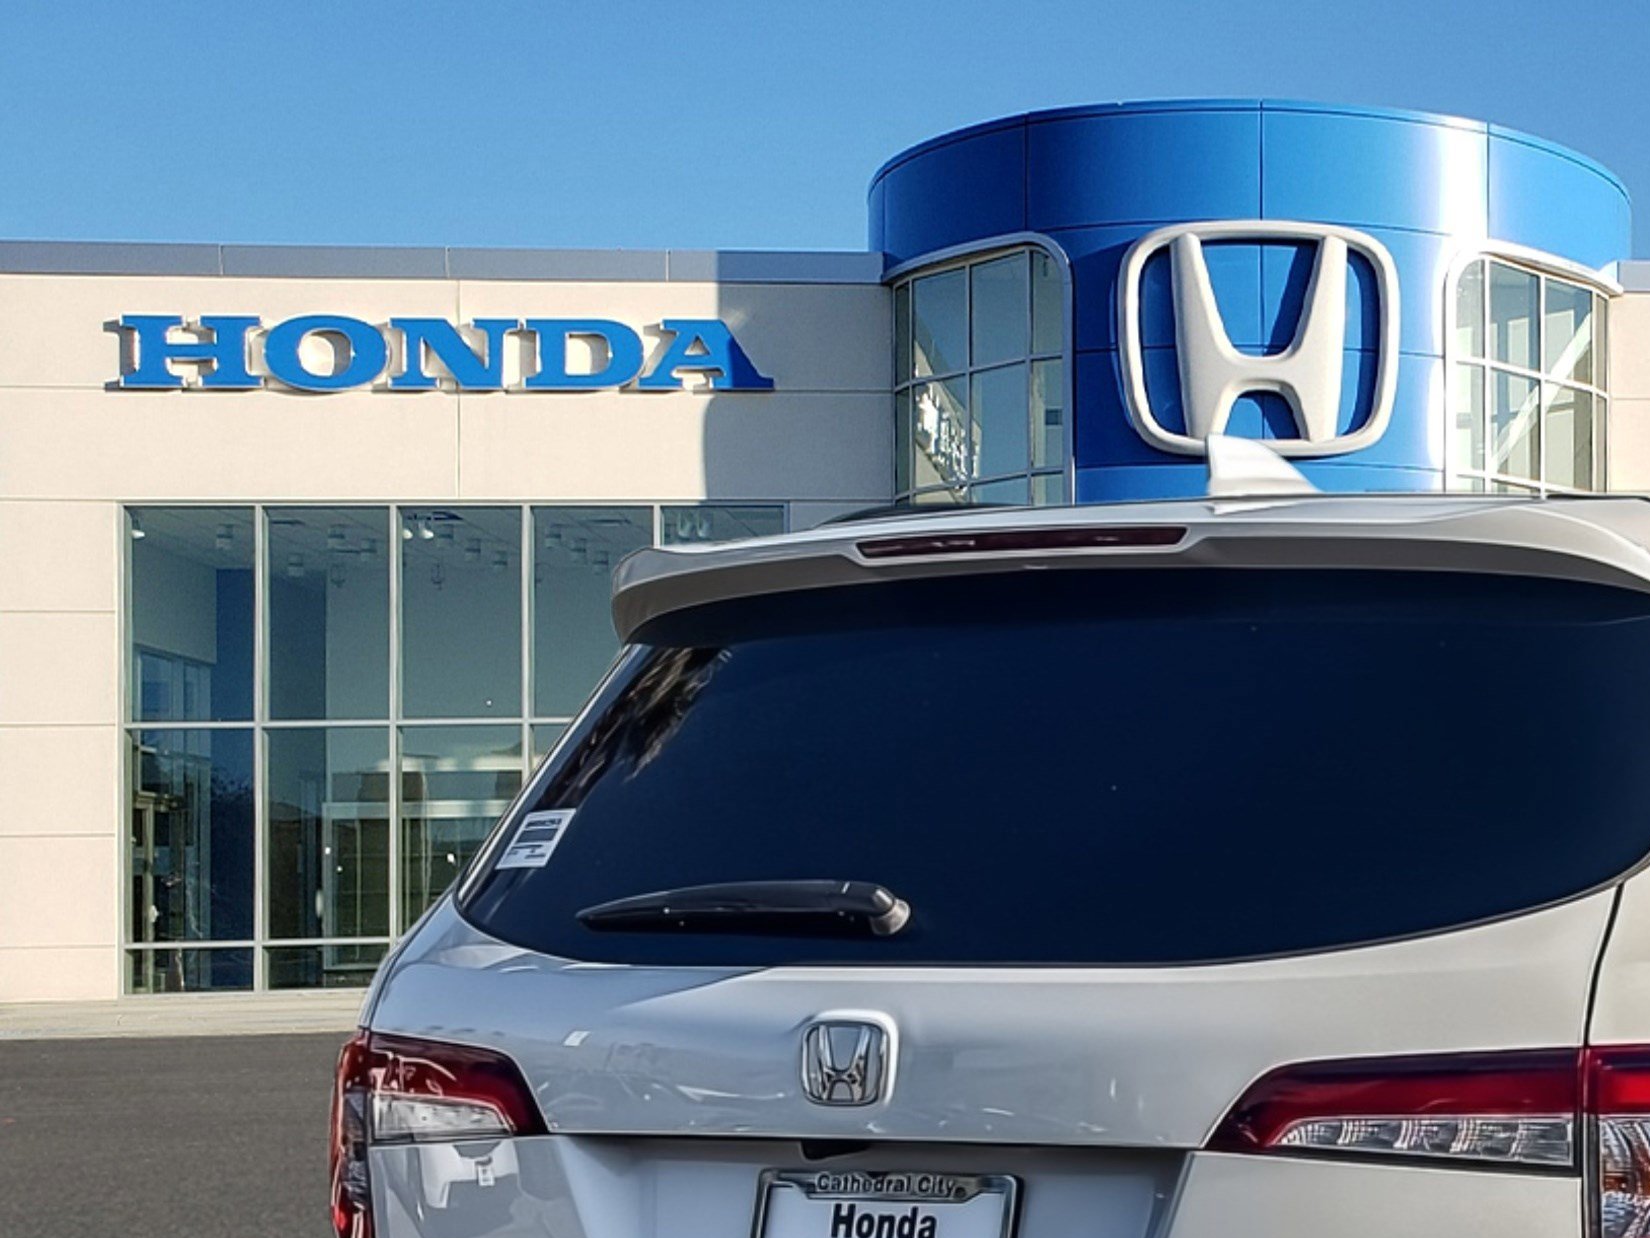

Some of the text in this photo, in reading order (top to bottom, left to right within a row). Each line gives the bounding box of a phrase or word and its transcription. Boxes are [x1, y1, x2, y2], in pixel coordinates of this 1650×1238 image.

[117, 314, 775, 392] HONDA
[815, 1174, 955, 1197] Cathedral City
